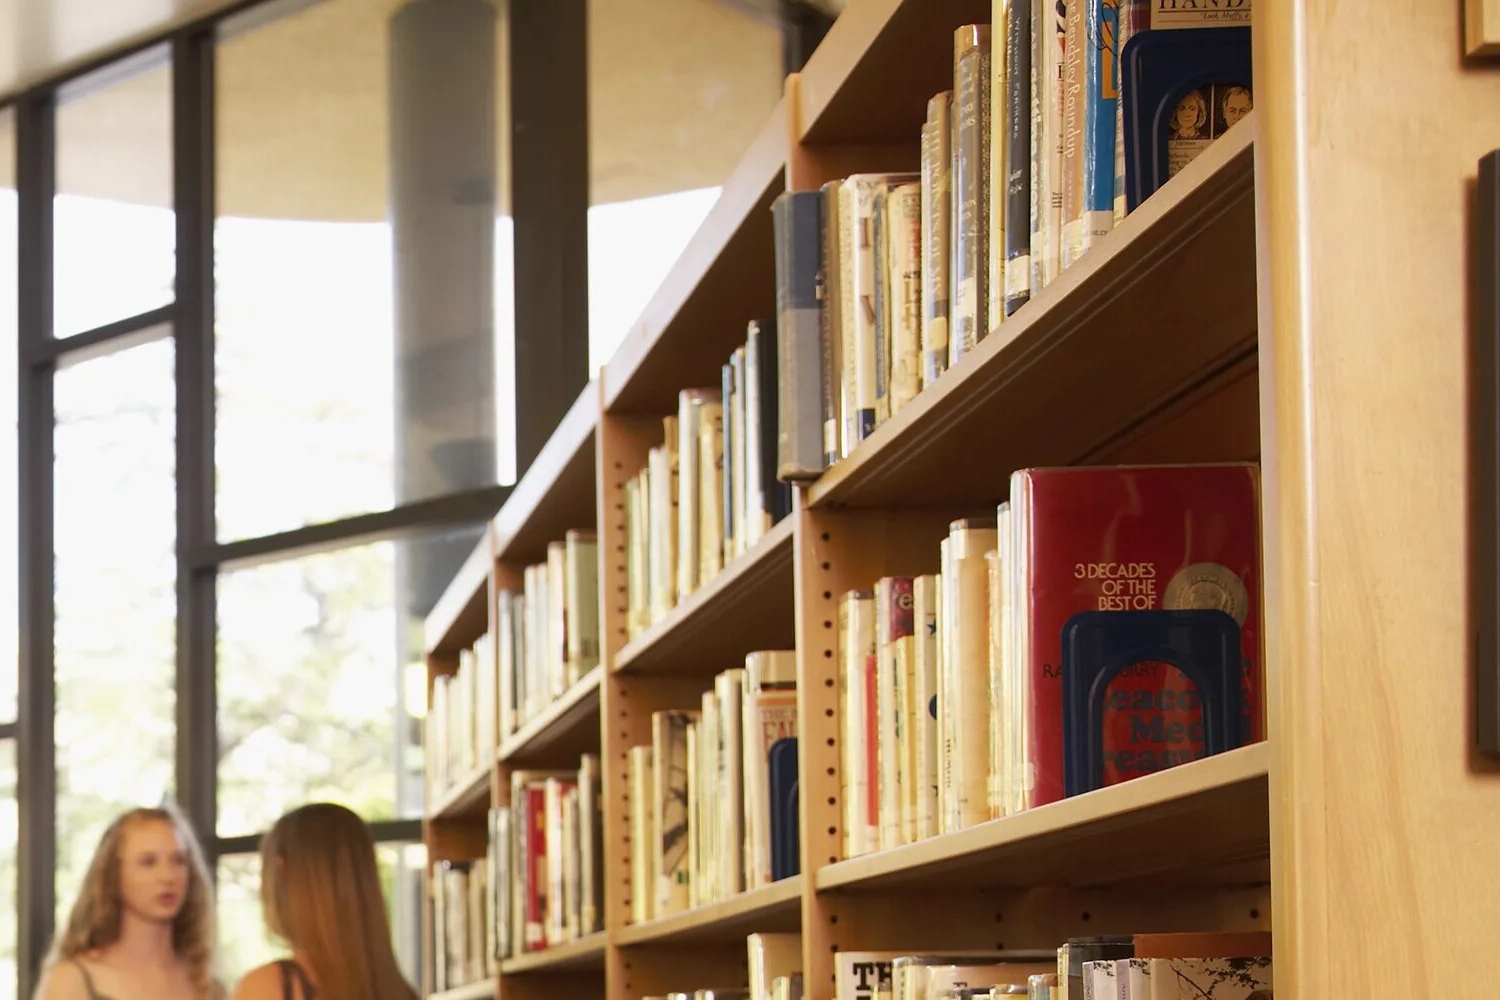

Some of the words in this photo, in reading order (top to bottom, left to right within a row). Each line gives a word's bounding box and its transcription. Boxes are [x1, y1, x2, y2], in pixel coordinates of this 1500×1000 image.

[1066, 14, 1083, 84] Benchley
[1065, 84, 1083, 158] Roundup
[1074, 565, 1085, 578] 3
[1088, 563, 1155, 578] DECADES
[1102, 580, 1126, 595] OF
[1127, 580, 1156, 595] THE
[1098, 596, 1132, 610] BEST
[1133, 596, 1157, 610] OF
[853, 961, 892, 991] TH
